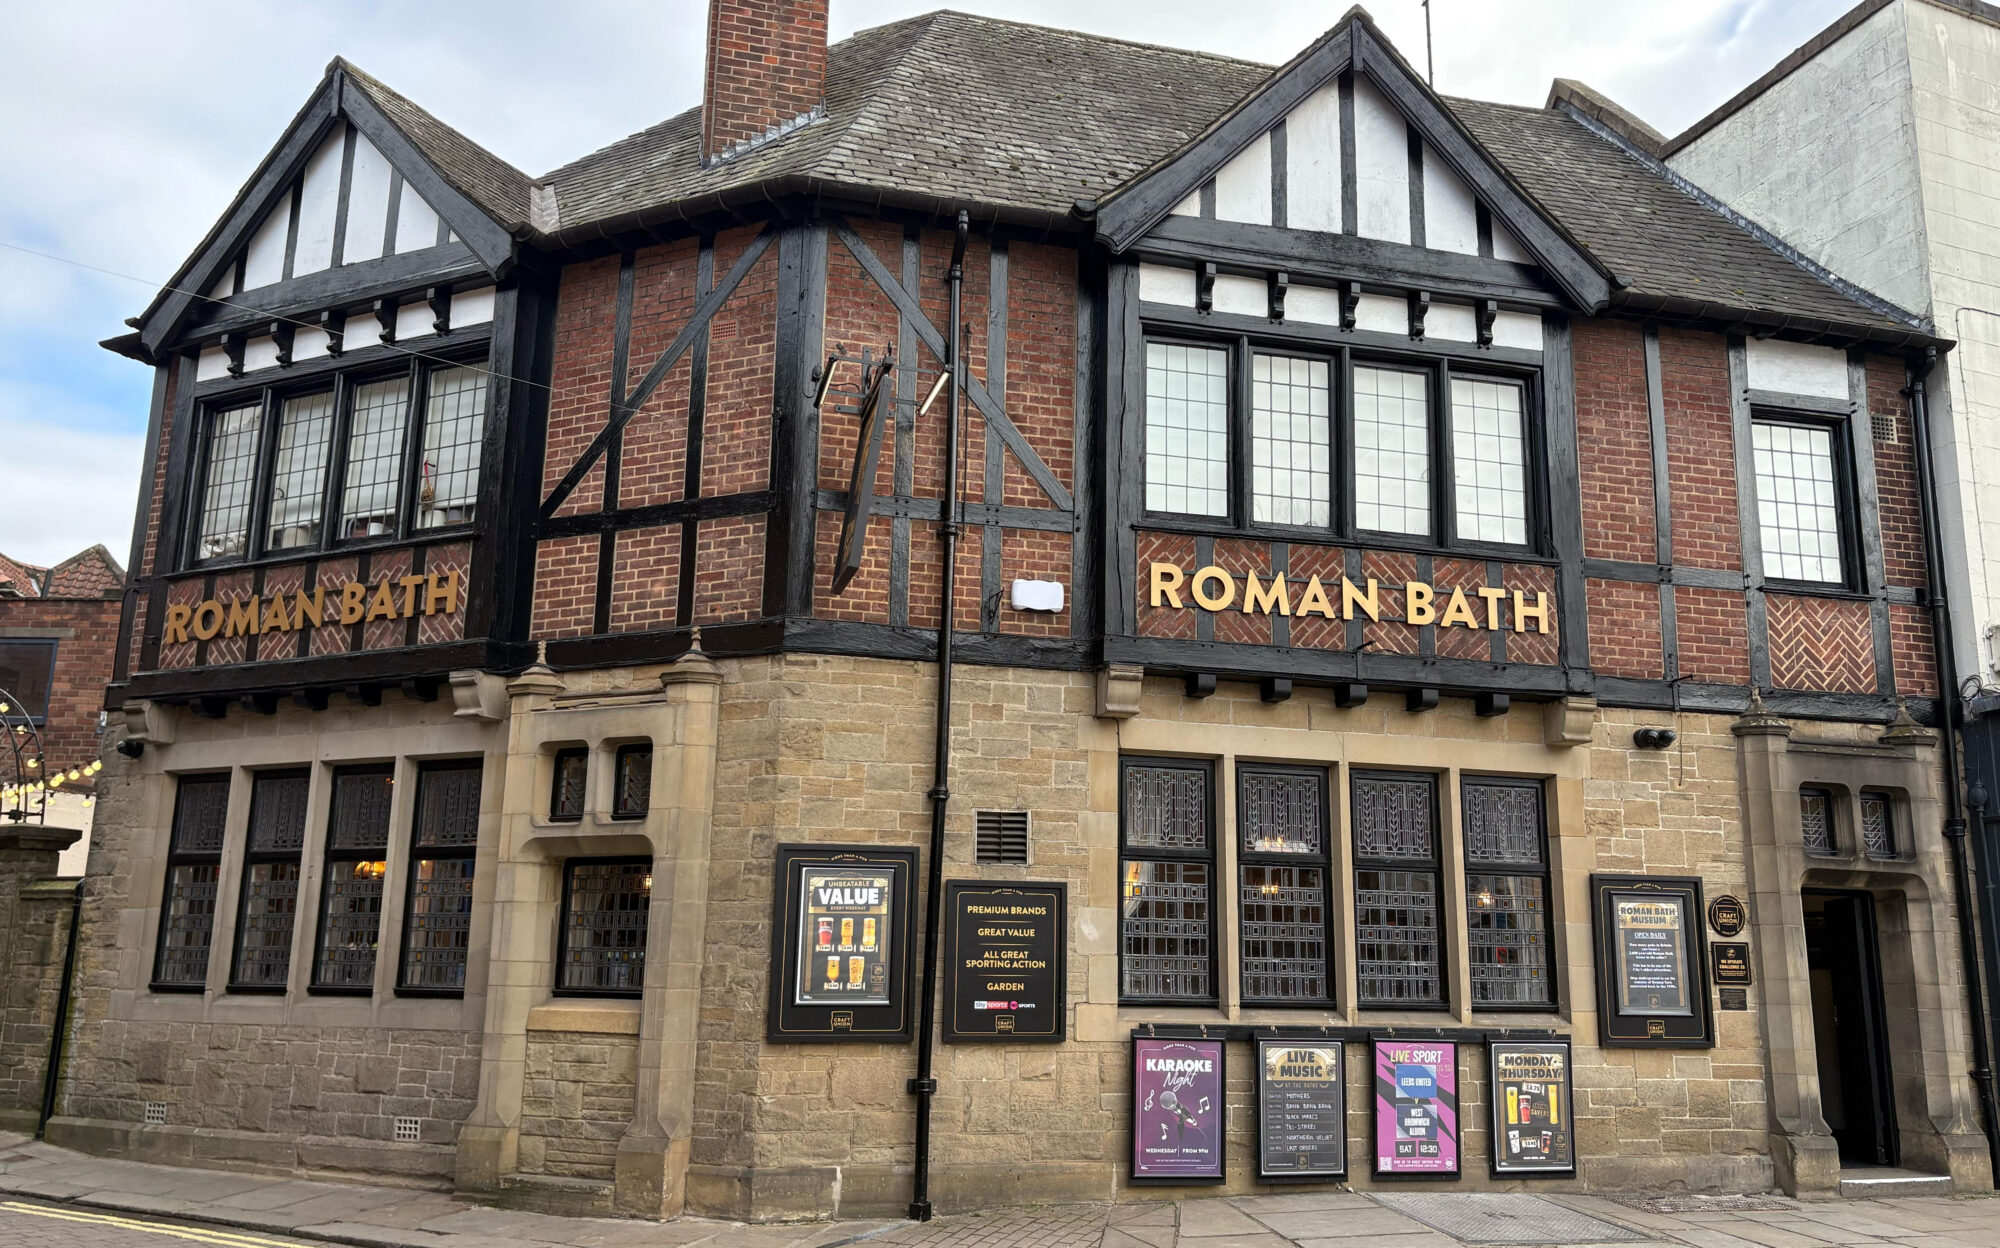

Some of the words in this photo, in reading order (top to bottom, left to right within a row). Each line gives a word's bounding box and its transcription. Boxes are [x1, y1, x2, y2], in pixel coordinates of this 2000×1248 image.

[1150, 562, 1378, 622] ROMAN
[1406, 581, 1549, 634] BATH
[166, 586, 325, 644] ROMAN
[341, 570, 459, 625] BATH
[818, 888, 879, 904] VALUE
[967, 906, 1009, 914] PREMIUM
[966, 960, 1010, 968] SPORTING
[987, 983, 1024, 991] GARDEN
[1288, 1051, 1314, 1063] LIVE
[1390, 1050, 1410, 1062] LIVE
[1413, 1050, 1442, 1063] SPORT
[1146, 1059, 1212, 1072] KARAOKE
[1281, 1066, 1322, 1077] MUSIC
[1502, 1069, 1559, 1078] THURSDAY
[1163, 1070, 1197, 1092] Night
[1401, 1078, 1414, 1086] LEEDS
[1416, 1078, 1431, 1086] UNITED
[1411, 1108, 1423, 1117] WEST
[1531, 1108, 1549, 1117] SAVERS
[1404, 1118, 1430, 1126] BROMWICH
[1410, 1127, 1425, 1135] ALBION
